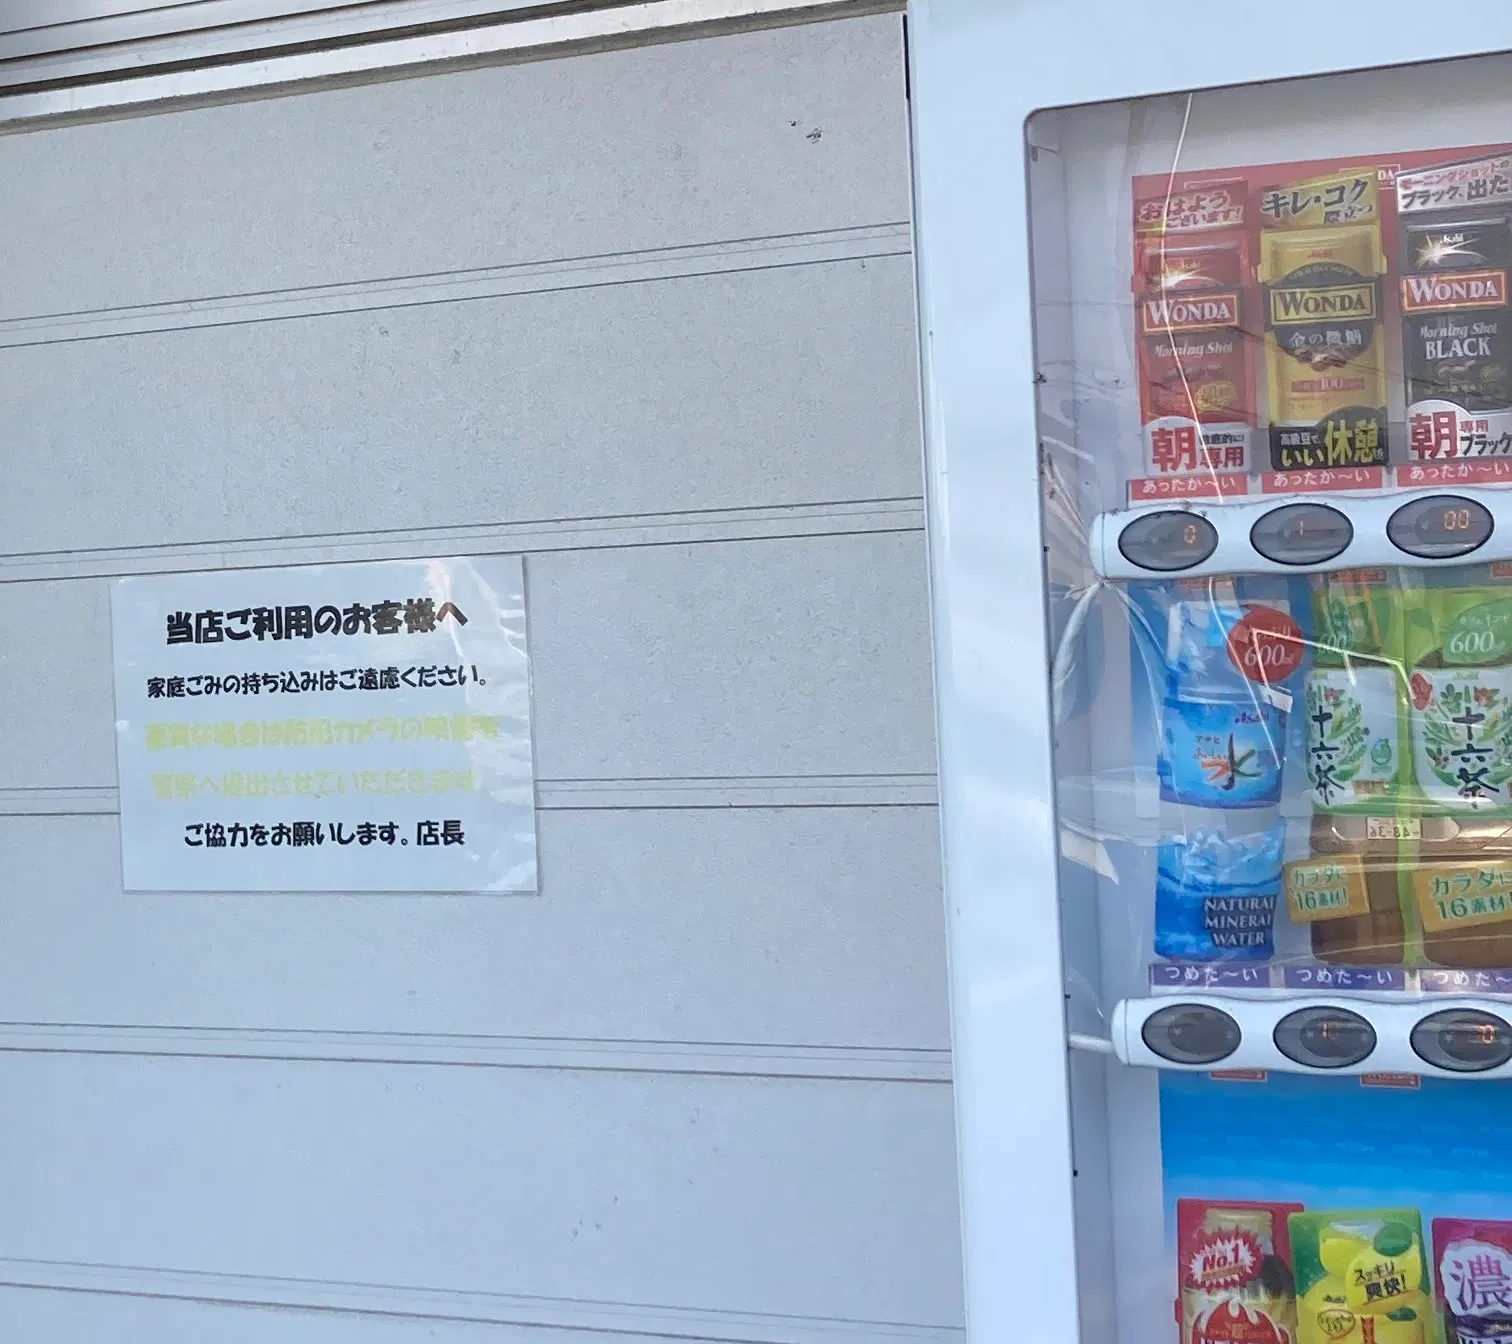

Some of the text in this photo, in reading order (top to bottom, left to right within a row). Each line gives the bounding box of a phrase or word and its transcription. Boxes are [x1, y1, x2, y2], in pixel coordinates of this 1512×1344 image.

[1278, 290, 1368, 317] WONDA
[1406, 278, 1499, 304] WONDA
[1425, 337, 1492, 361] BLACK
[1409, 411, 1458, 460] 朝
[1151, 426, 1197, 473] 朝
[1200, 446, 1245, 470] 専用
[166, 597, 469, 646] 当店ご利用のお客様へ
[147, 664, 487, 699] 家庭ごみの持ち込みはご遠慮ください。
[1213, 931, 1266, 947] WATER
